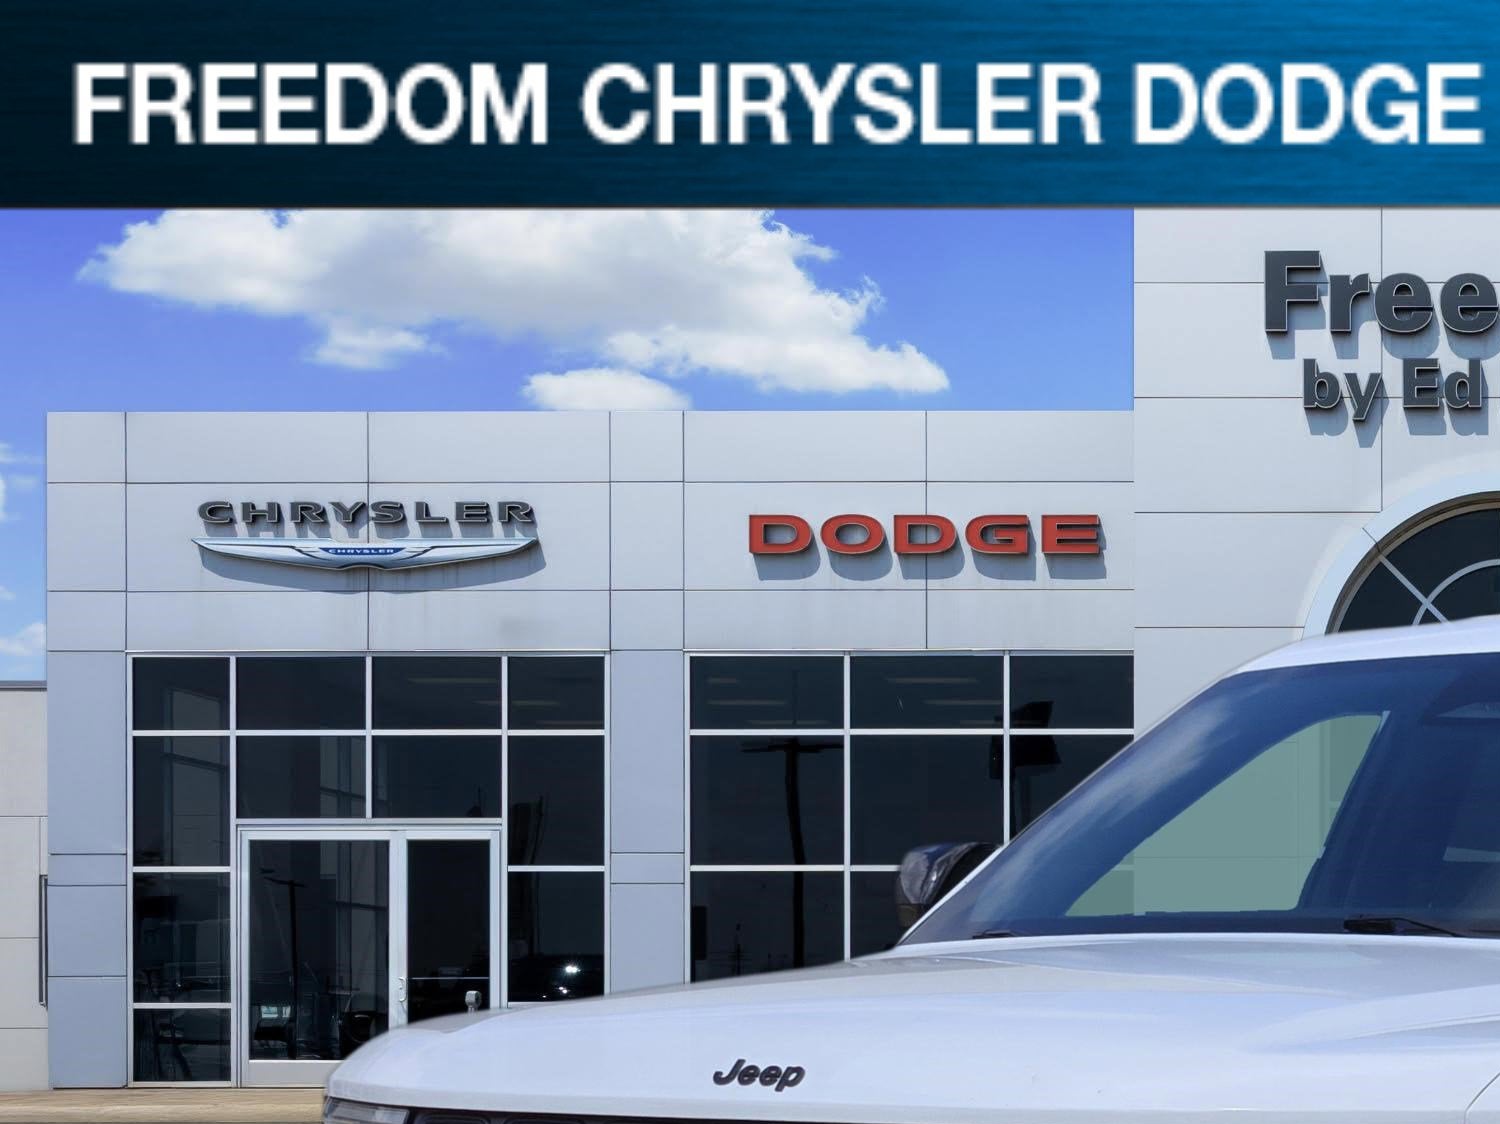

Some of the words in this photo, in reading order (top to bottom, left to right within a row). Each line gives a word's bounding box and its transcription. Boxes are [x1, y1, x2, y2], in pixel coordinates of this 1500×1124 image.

[1302, 357, 1383, 422] by
[1402, 357, 1484, 410] Ed
[196, 499, 537, 525] CHRYSLER
[747, 513, 1102, 556] DODGE
[712, 1058, 806, 1093] Jeep
